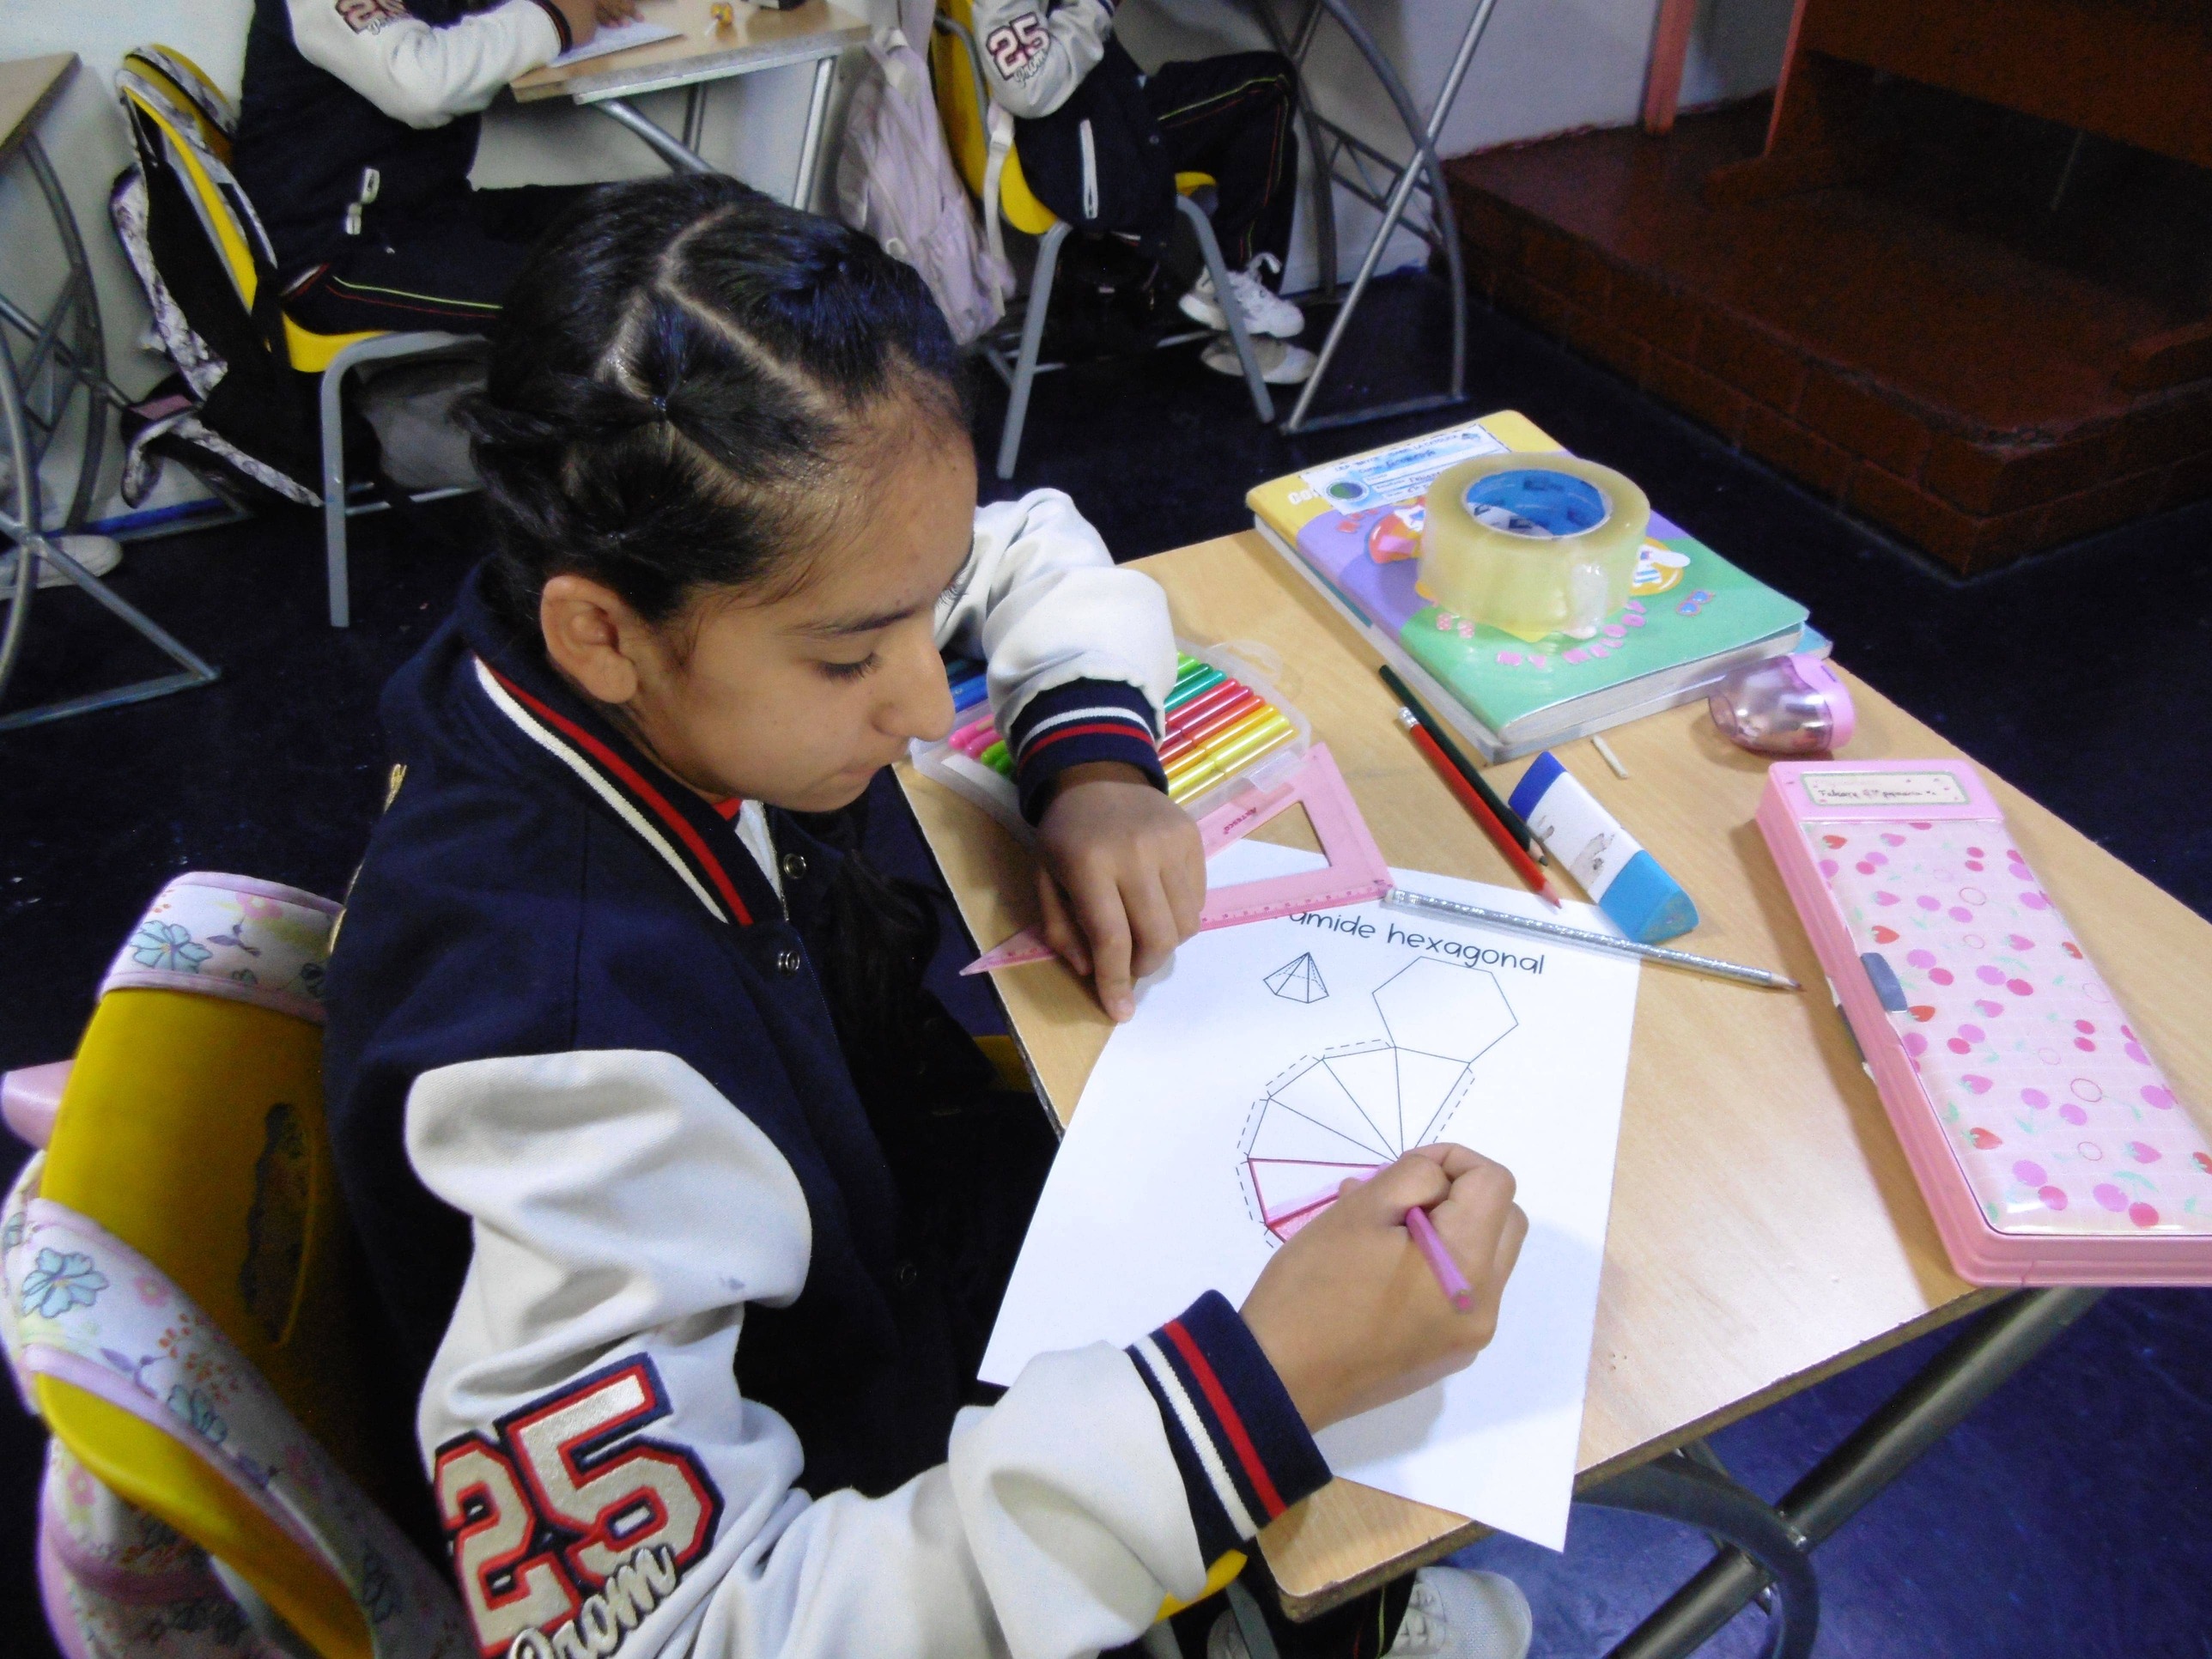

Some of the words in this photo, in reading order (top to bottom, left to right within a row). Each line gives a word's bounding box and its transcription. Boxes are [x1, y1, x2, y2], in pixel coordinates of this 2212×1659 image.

[986, 12, 1051, 81] 25
[1387, 922, 1546, 975] hexagonal
[434, 1352, 725, 1659] 25
